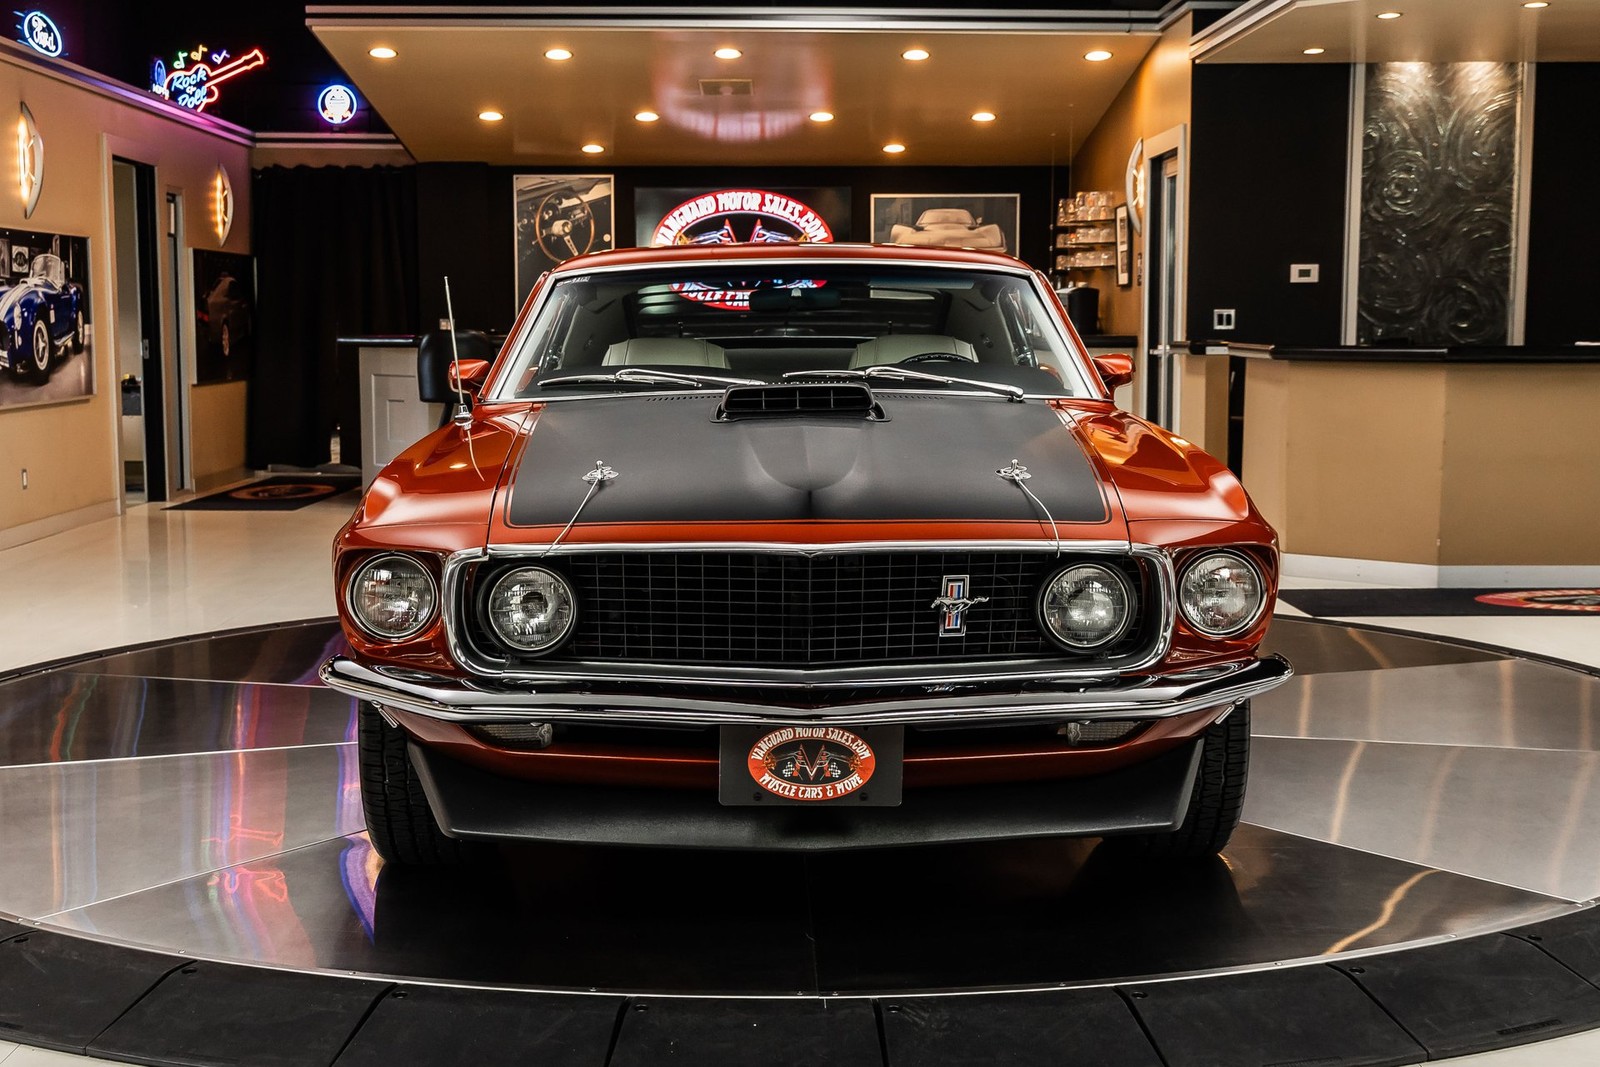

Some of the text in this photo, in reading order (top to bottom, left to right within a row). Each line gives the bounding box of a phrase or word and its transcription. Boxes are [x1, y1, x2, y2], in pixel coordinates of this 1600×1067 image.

[171, 67, 207, 92] Rock
[655, 191, 828, 246] VANGUARD MOTOR SALES.COM
[751, 727, 872, 761] VANGUARD MOTOR SALES.COM
[759, 773, 863, 799] MUSCLE CARS & MORE
